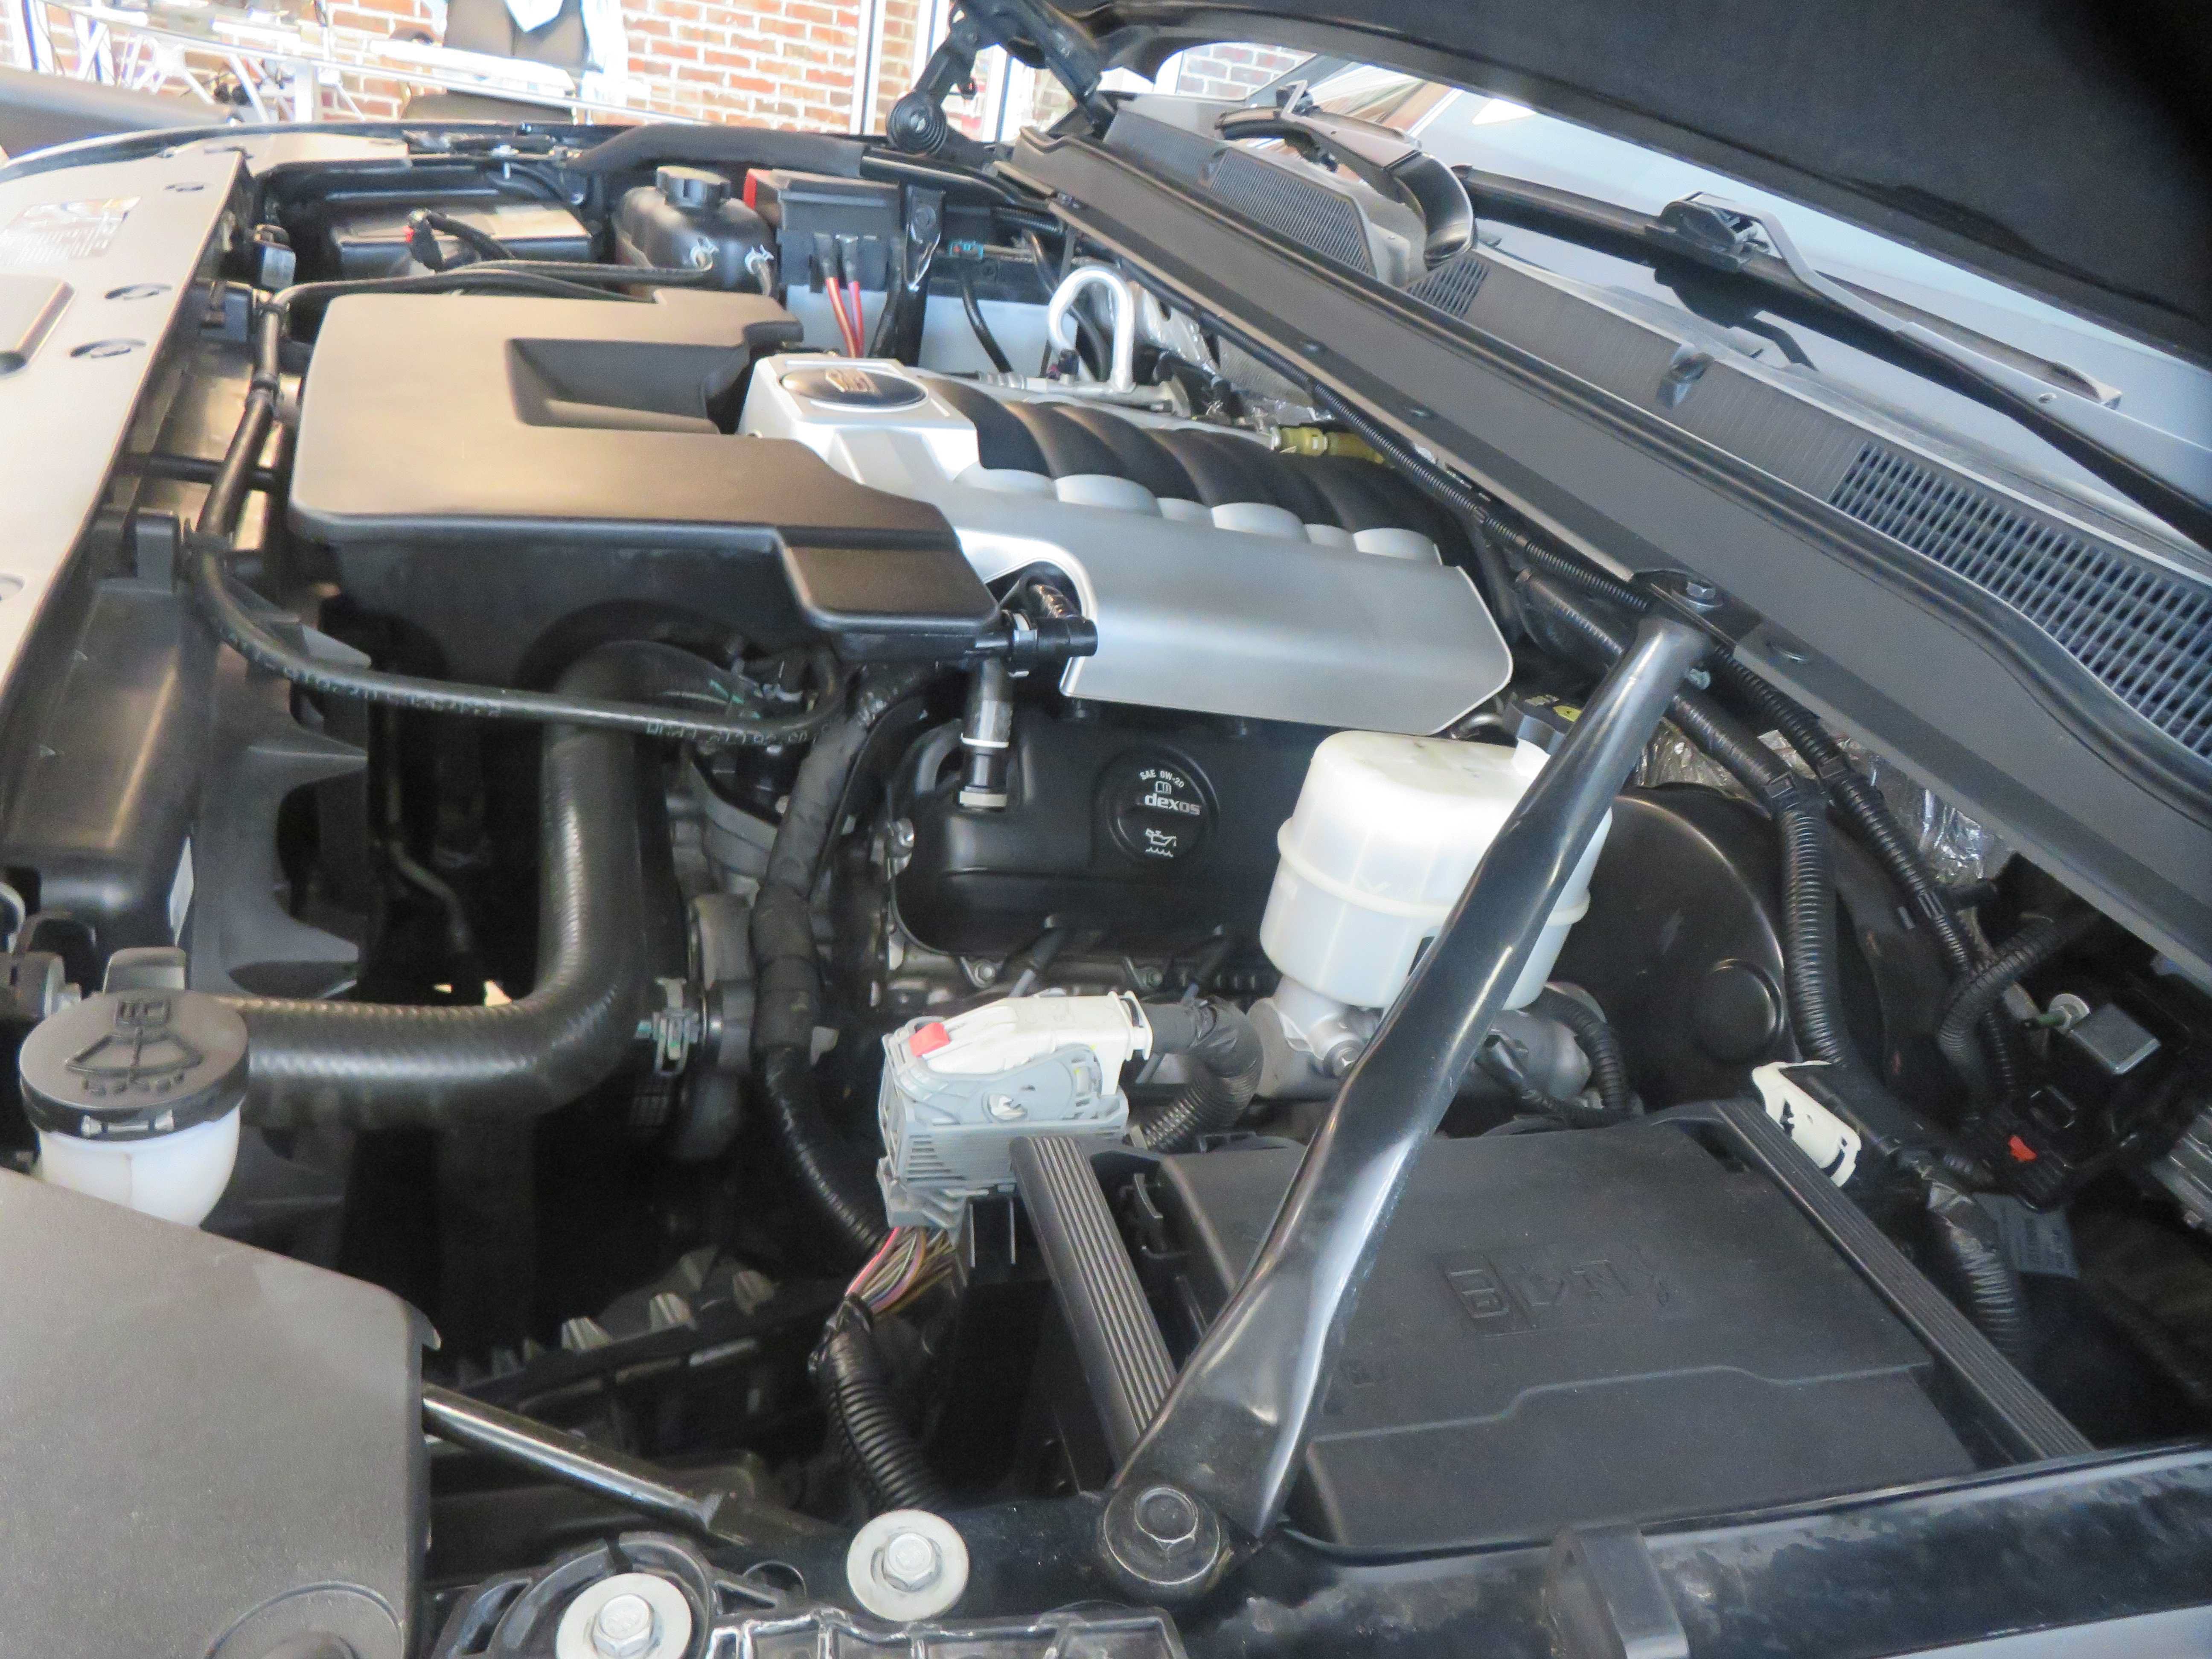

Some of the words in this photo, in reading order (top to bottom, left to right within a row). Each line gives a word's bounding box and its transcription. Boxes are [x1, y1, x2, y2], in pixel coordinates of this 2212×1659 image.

[1140, 769, 1156, 780] SAE
[1160, 771, 1184, 788] 0W-20
[1144, 793, 1200, 815] dexos
